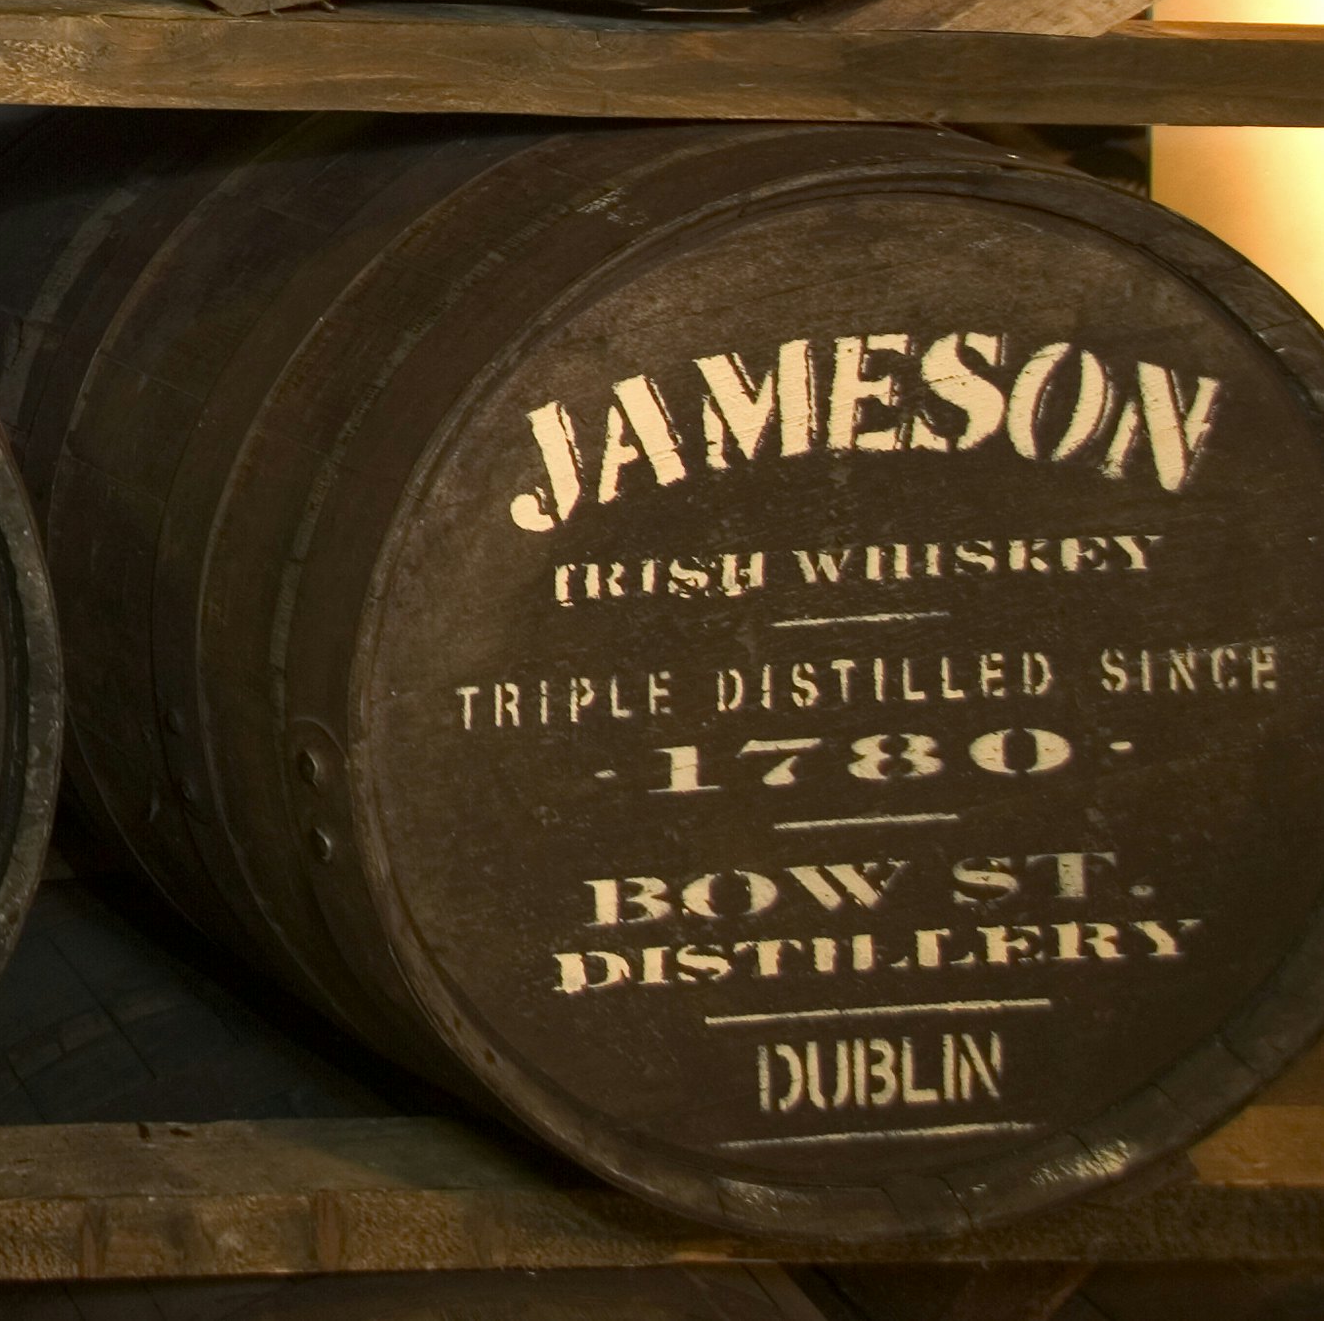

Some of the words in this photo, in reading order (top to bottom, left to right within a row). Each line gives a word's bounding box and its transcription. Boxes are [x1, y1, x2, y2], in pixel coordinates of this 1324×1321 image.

[509, 331, 1222, 533] JAMESON
[552, 551, 765, 607] IRISH
[792, 533, 1164, 584] WHISKEY
[457, 671, 673, 731] TRIPLE
[715, 651, 1053, 711] DISTILLED
[1099, 645, 1280, 694] SINCE
[582, 857, 911, 926] BOW
[951, 851, 1154, 904] ST.
[552, 918, 1204, 995] DISTILLERY
[757, 1032, 1004, 1113] DUBLIN
